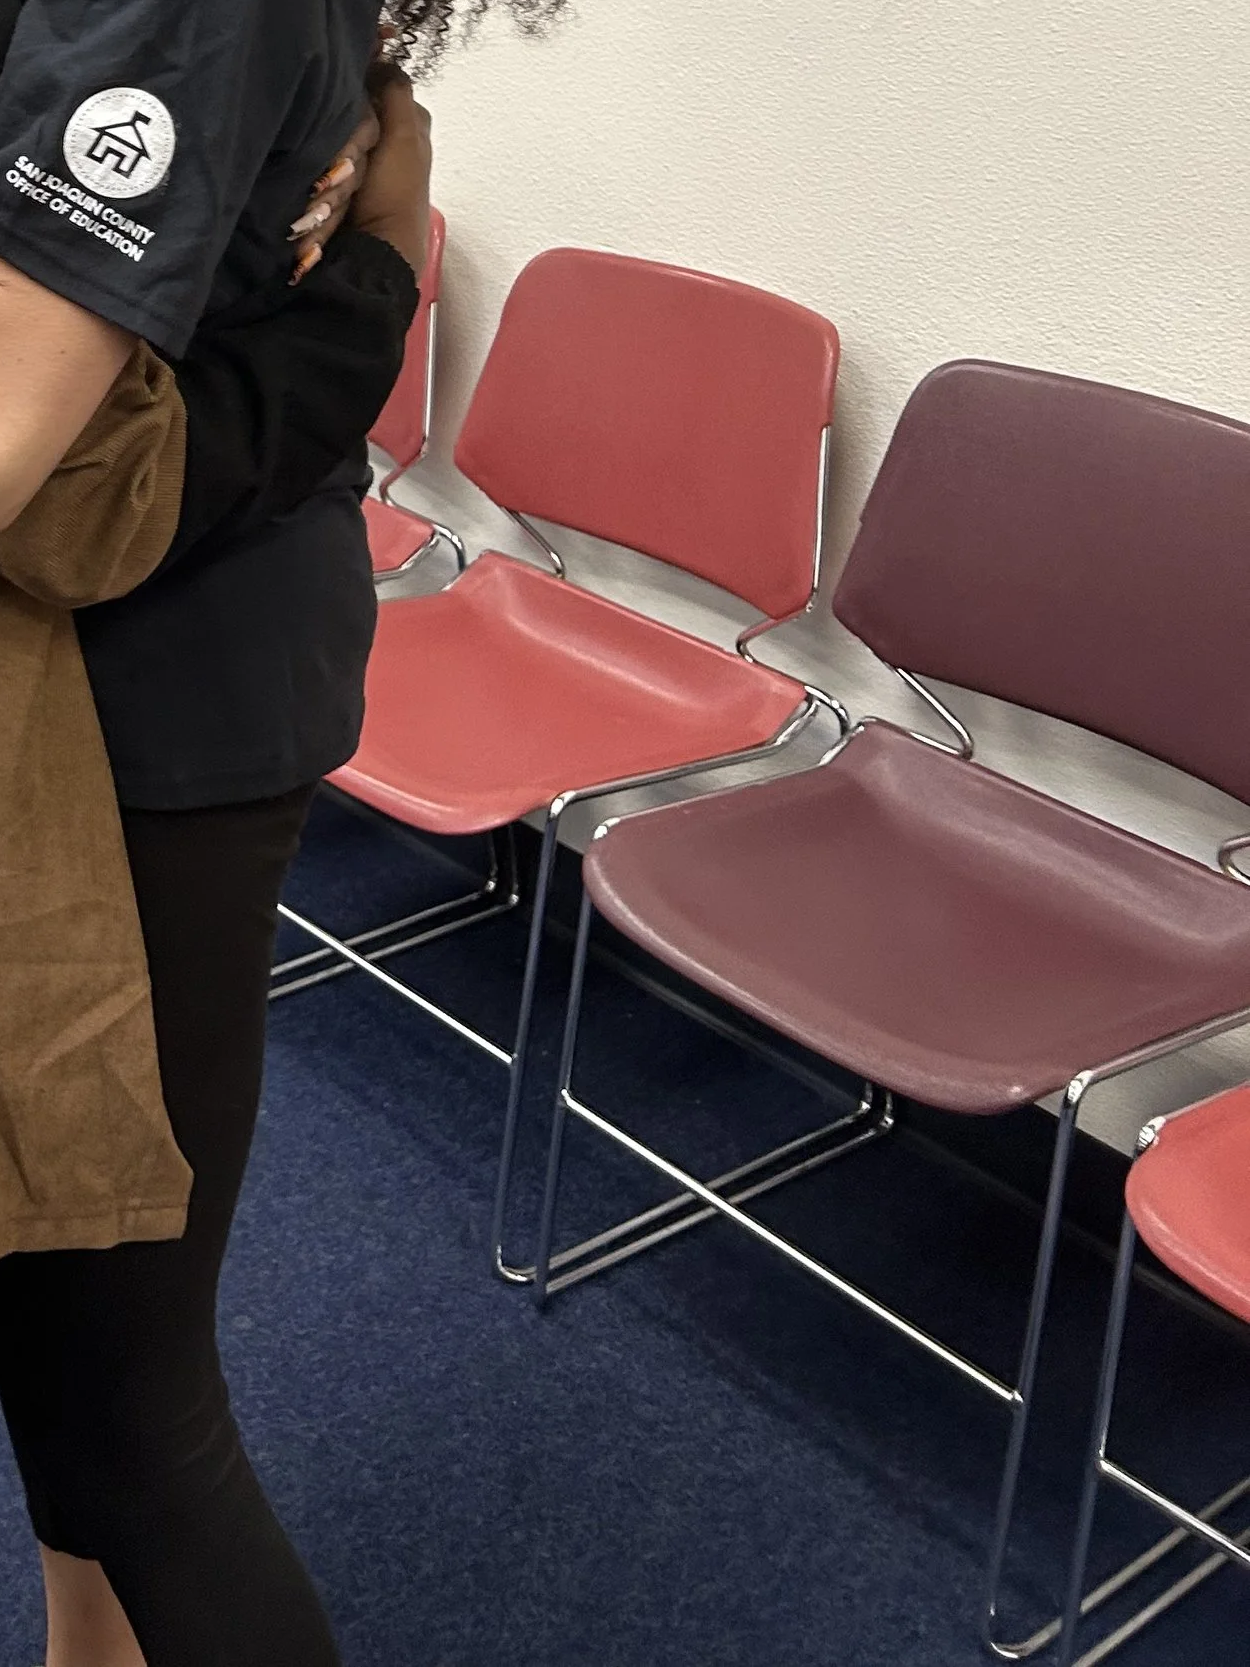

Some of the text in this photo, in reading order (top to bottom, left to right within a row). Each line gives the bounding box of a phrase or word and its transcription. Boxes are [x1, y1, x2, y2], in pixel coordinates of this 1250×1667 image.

[5, 169, 145, 262] OFFICE OF EDUCATION
[14, 155, 156, 244] SAN JOAQUIN COUNTY
